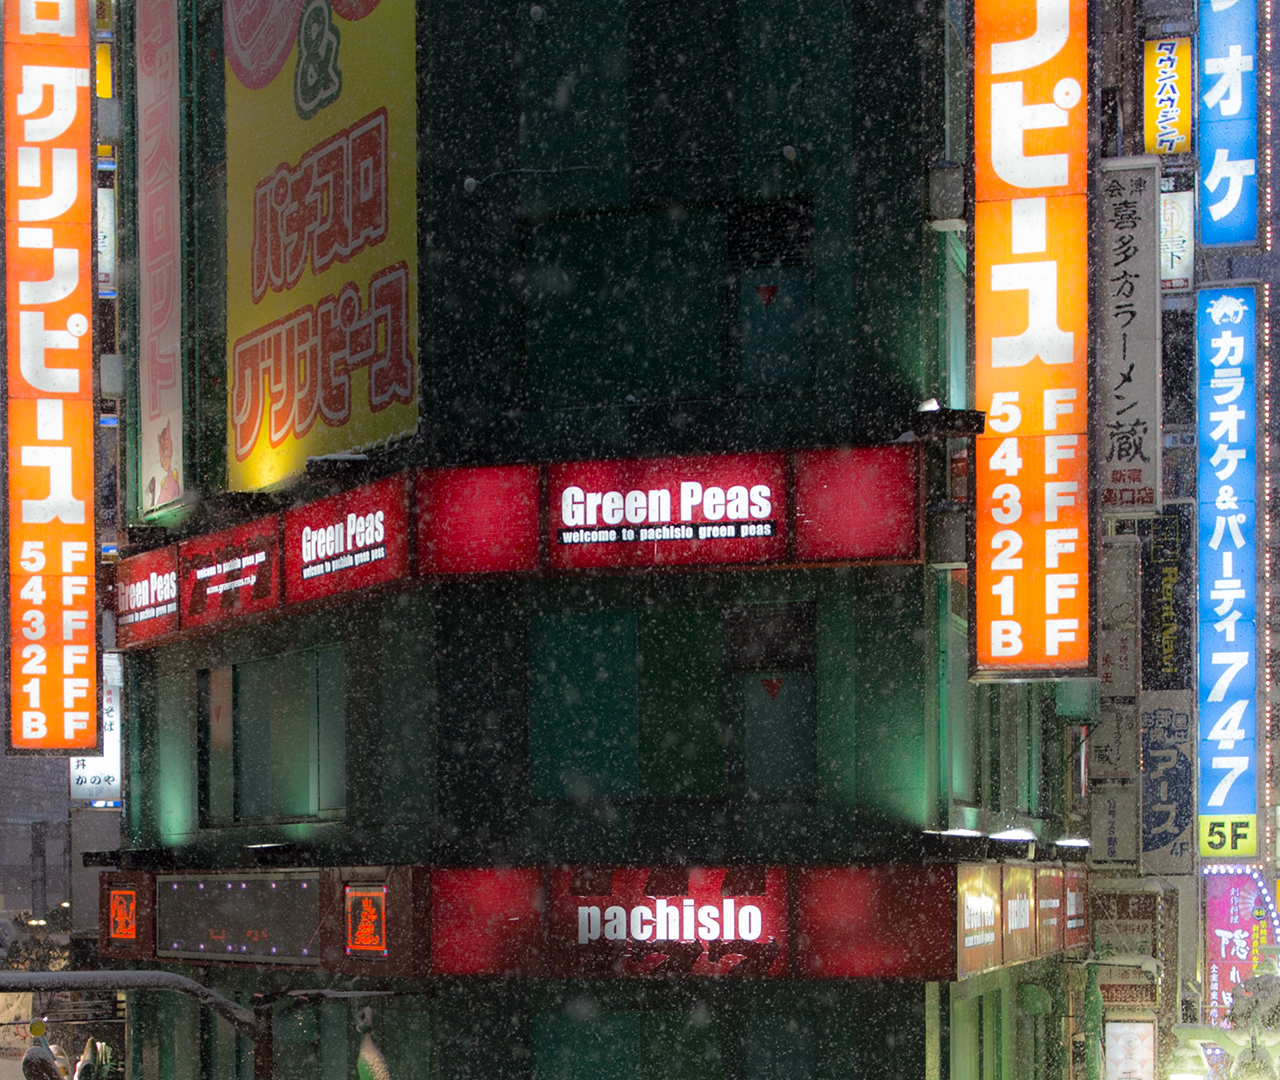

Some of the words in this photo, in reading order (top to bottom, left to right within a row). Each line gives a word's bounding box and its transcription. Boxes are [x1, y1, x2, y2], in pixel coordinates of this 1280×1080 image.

[252, 108, 388, 304] パチスロ
[989, 392, 1022, 430] 5
[1043, 389, 1075, 430] F
[989, 436, 1022, 476] 4
[1043, 436, 1075, 473] F
[561, 486, 672, 528] Green
[679, 481, 772, 522] Peas
[989, 482, 1022, 525] 3
[1043, 482, 1075, 521] F
[301, 523, 344, 563] Green
[346, 509, 385, 551] Peas
[562, 528, 617, 543] welcome
[621, 528, 634, 541] to
[639, 524, 694, 541] pachislo
[698, 526, 736, 541] green
[740, 522, 772, 538] peas
[989, 529, 1022, 569] 2
[1043, 529, 1075, 567] F
[20, 541, 46, 572] 5
[62, 542, 89, 572] F
[302, 562, 324, 580] welcome
[325, 561, 331, 573] to
[331, 554, 353, 572] pachislo
[354, 551, 370, 568] green
[370, 547, 385, 562] peas
[20, 576, 46, 604] 4
[62, 576, 89, 605] F
[150, 571, 177, 602] Peas
[989, 576, 1022, 615] 1
[1043, 575, 1075, 613] F
[20, 609, 46, 640] 3
[62, 611, 89, 640] F
[989, 621, 1022, 656] B
[1043, 620, 1075, 655] F
[20, 644, 47, 674] 2
[62, 645, 89, 674] F
[20, 678, 41, 708] 1
[62, 678, 89, 708] F
[20, 711, 47, 739] B
[62, 712, 89, 739] F
[1207, 821, 1250, 850] 5F
[577, 898, 763, 944] pachislo
